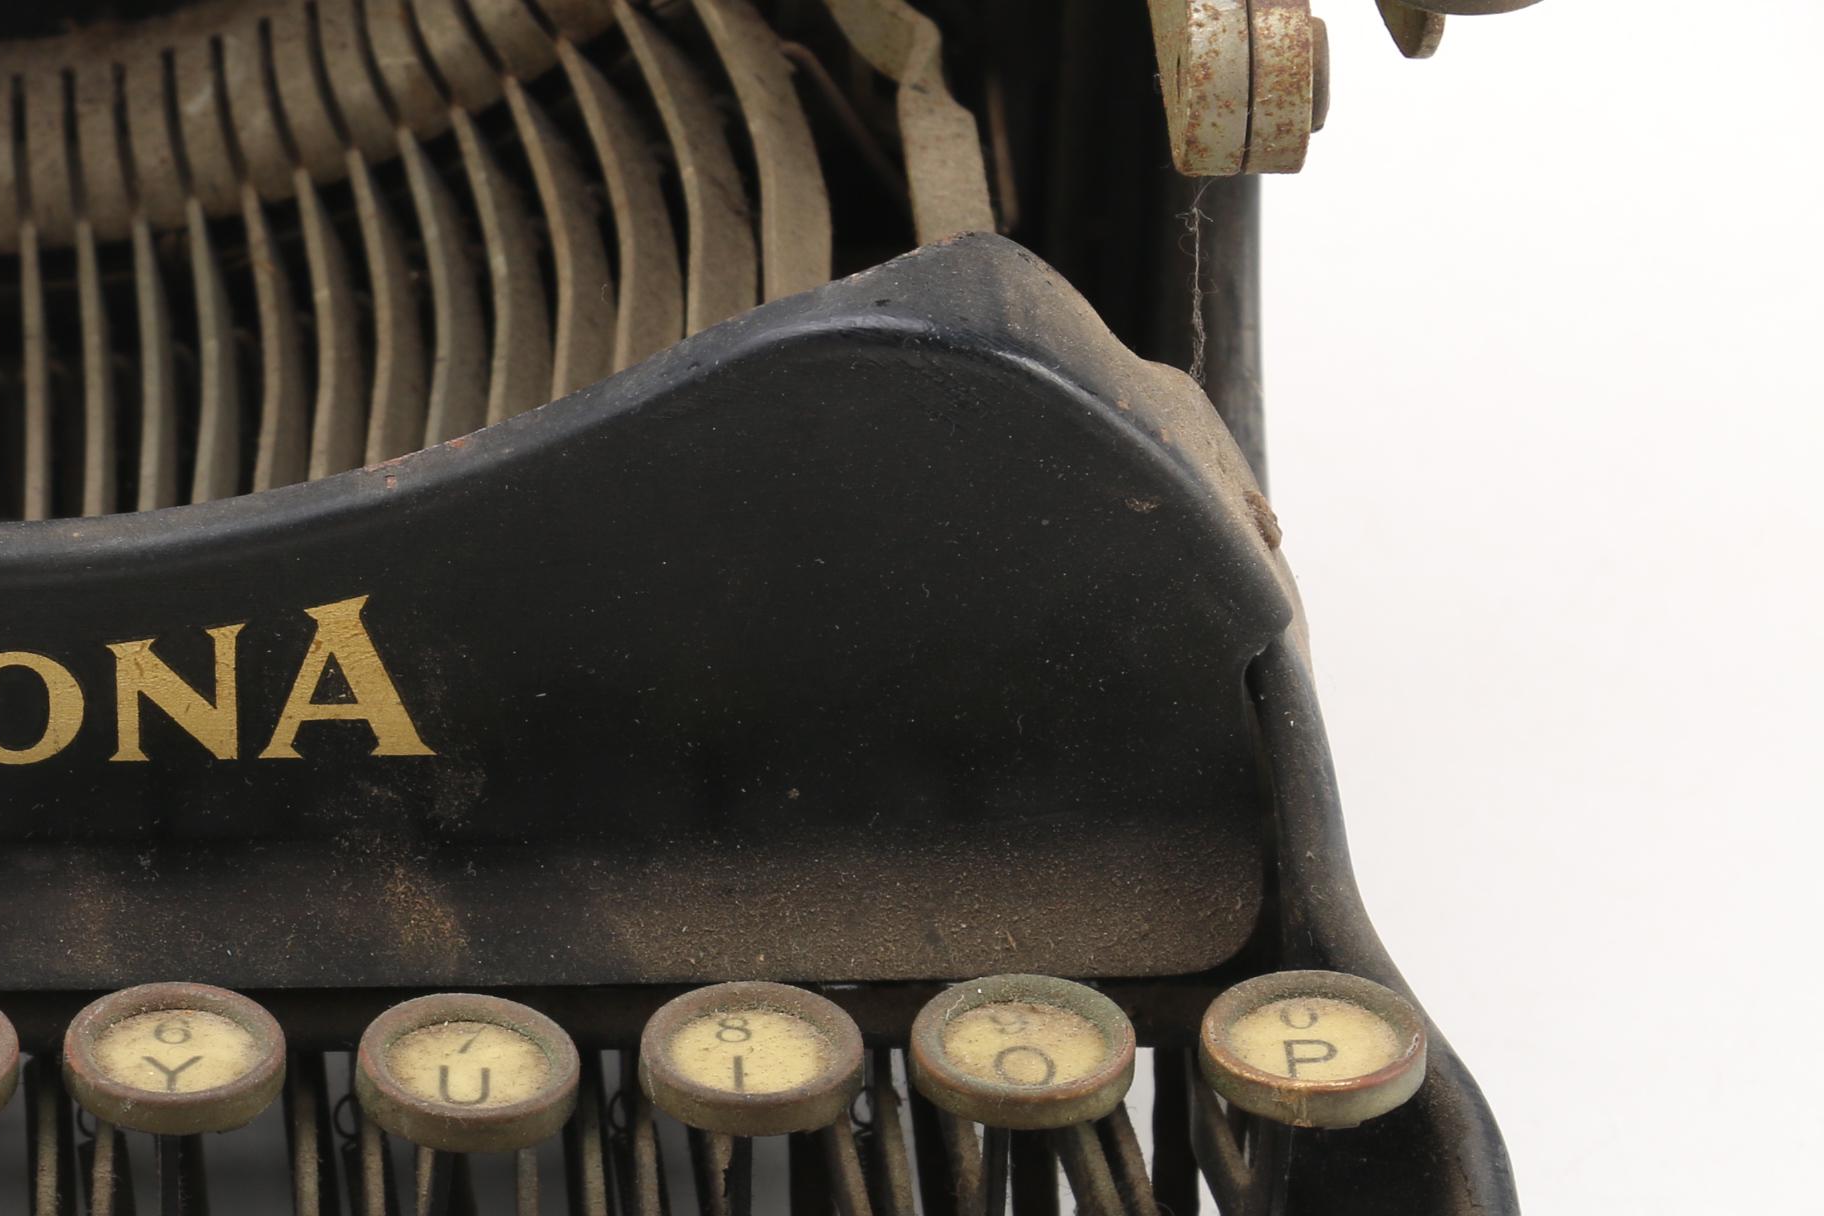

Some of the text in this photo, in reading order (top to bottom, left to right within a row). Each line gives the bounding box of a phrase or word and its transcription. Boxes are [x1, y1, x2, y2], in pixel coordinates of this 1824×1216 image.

[153, 1019, 192, 1045] 6
[715, 1017, 752, 1043] 8
[142, 1055, 203, 1093] Y
[1282, 1039, 1337, 1079] P
[438, 1065, 490, 1104] U
